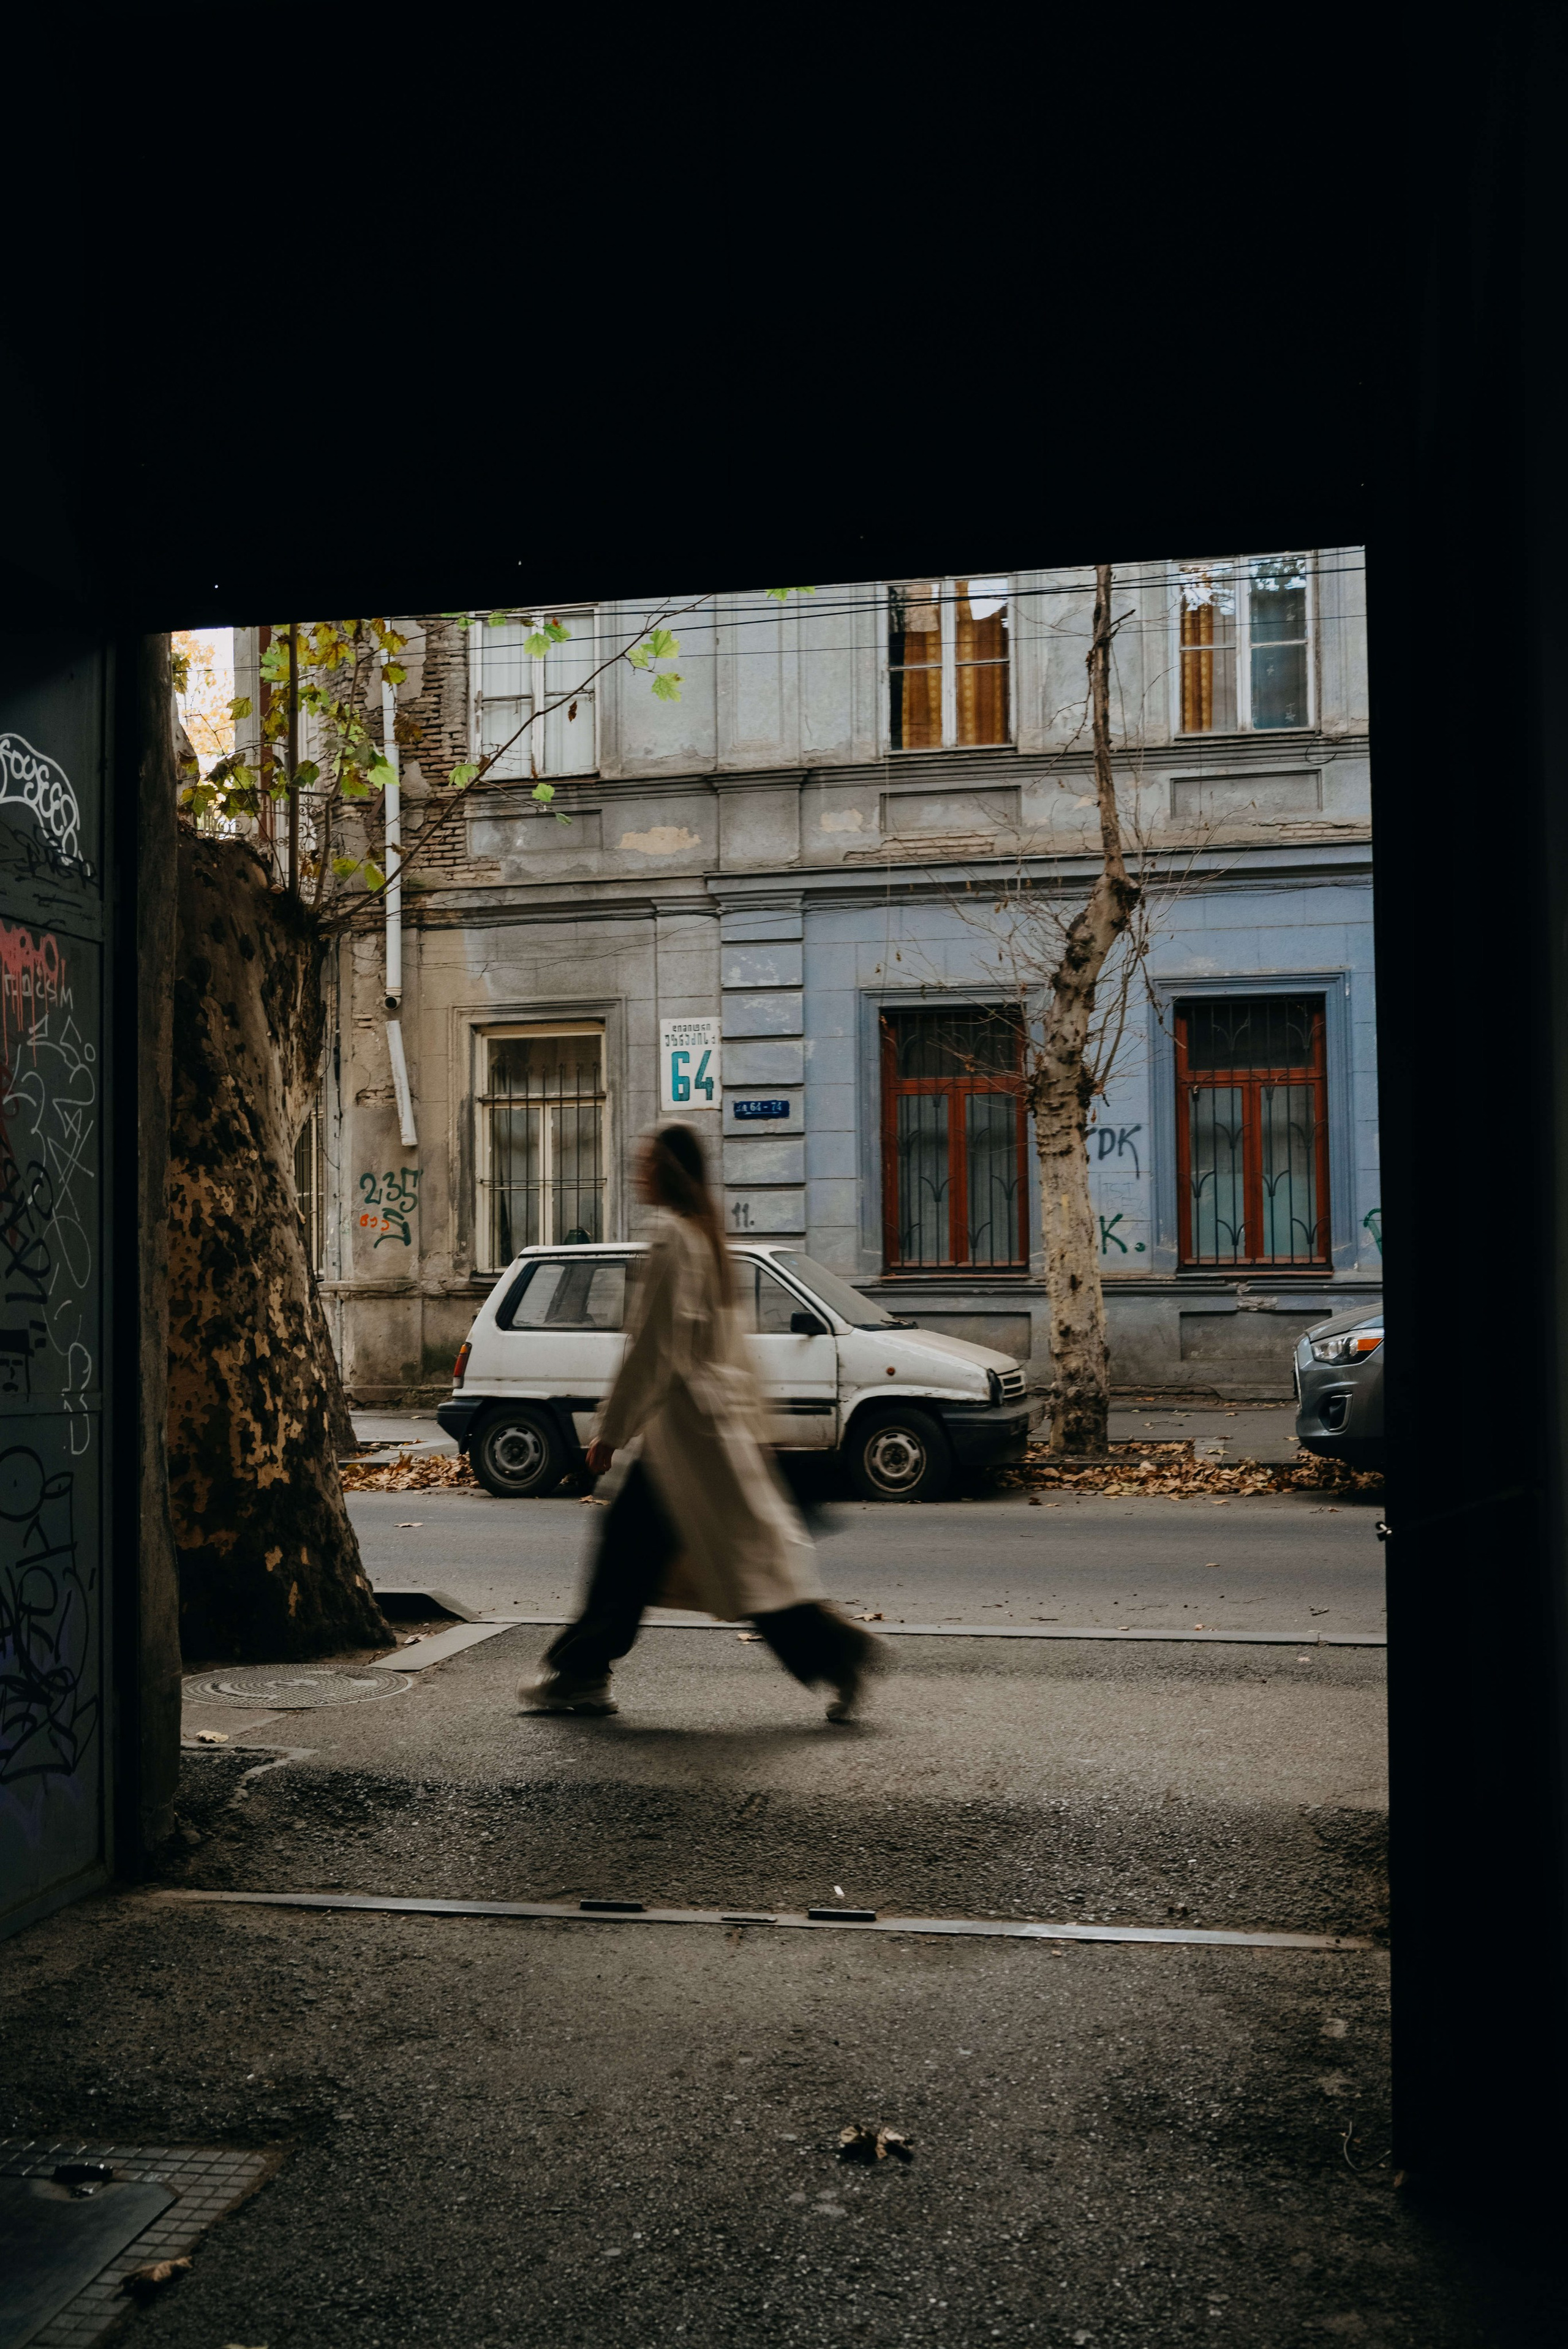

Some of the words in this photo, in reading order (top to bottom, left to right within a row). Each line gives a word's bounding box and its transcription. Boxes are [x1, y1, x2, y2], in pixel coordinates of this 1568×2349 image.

[671, 1050, 714, 1101] 64
[750, 1102, 761, 1111] 64
[771, 1102, 782, 1110] 74
